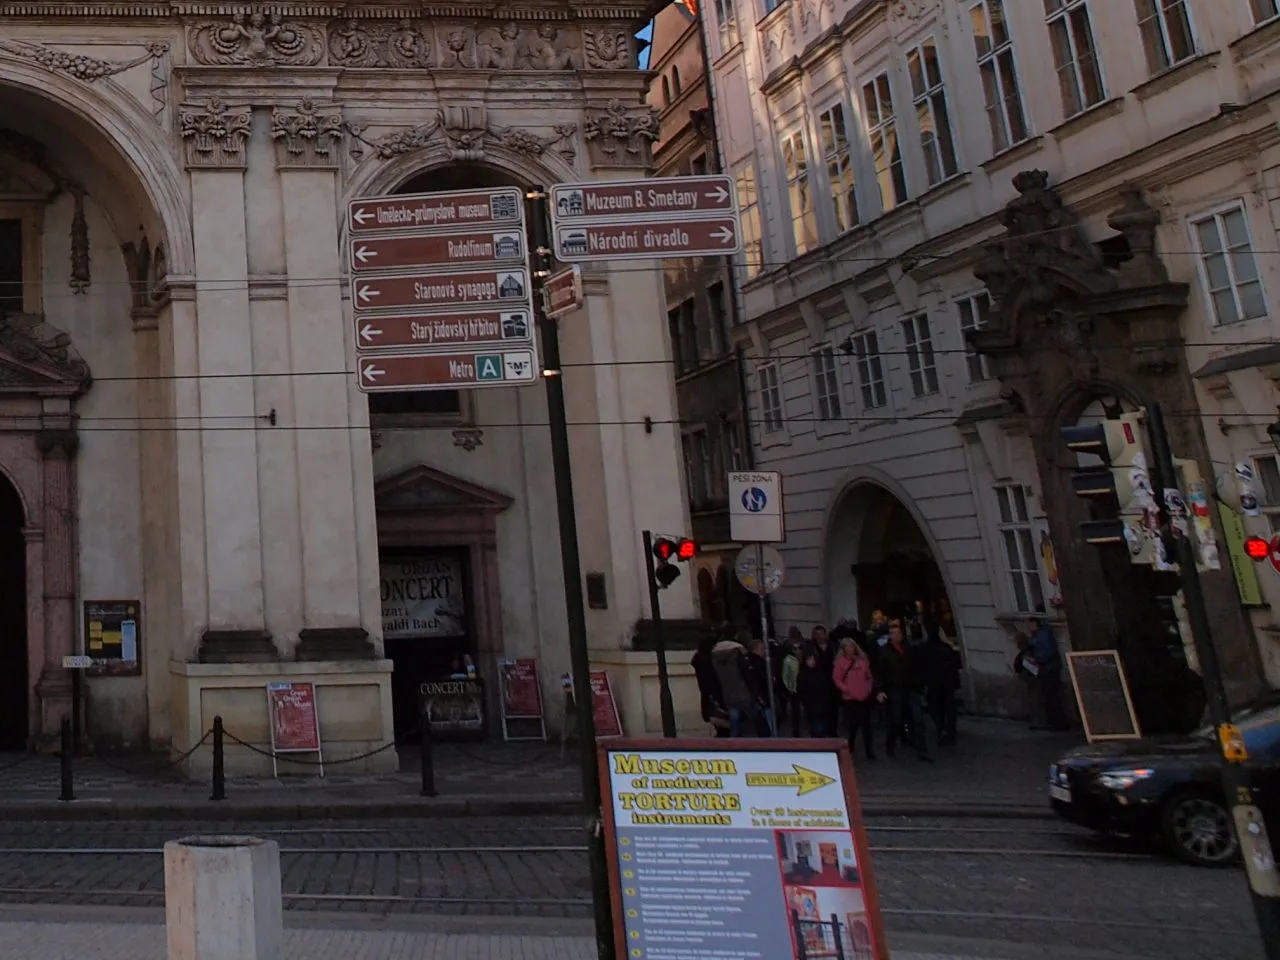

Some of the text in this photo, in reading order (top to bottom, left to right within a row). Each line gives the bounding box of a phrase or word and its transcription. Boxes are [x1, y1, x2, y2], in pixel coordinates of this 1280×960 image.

[586, 189, 698, 210] Muzeum B. Smetany
[448, 240, 492, 258] Rudolfinum
[589, 228, 689, 250] Národní divadlo
[414, 280, 496, 300] Staronová synagoga
[410, 321, 434, 342] Starý
[434, 320, 468, 341] židovský
[449, 360, 473, 379] Metro
[482, 358, 497, 377] A
[380, 576, 453, 601] ONCERT
[413, 617, 441, 630] Bach
[420, 681, 465, 695] CONCERT
[613, 754, 737, 774] Museum
[632, 776, 723, 789] of medieval
[749, 775, 767, 784] OPEN
[768, 775, 787, 784] DAILY
[619, 792, 741, 811] TORTURE
